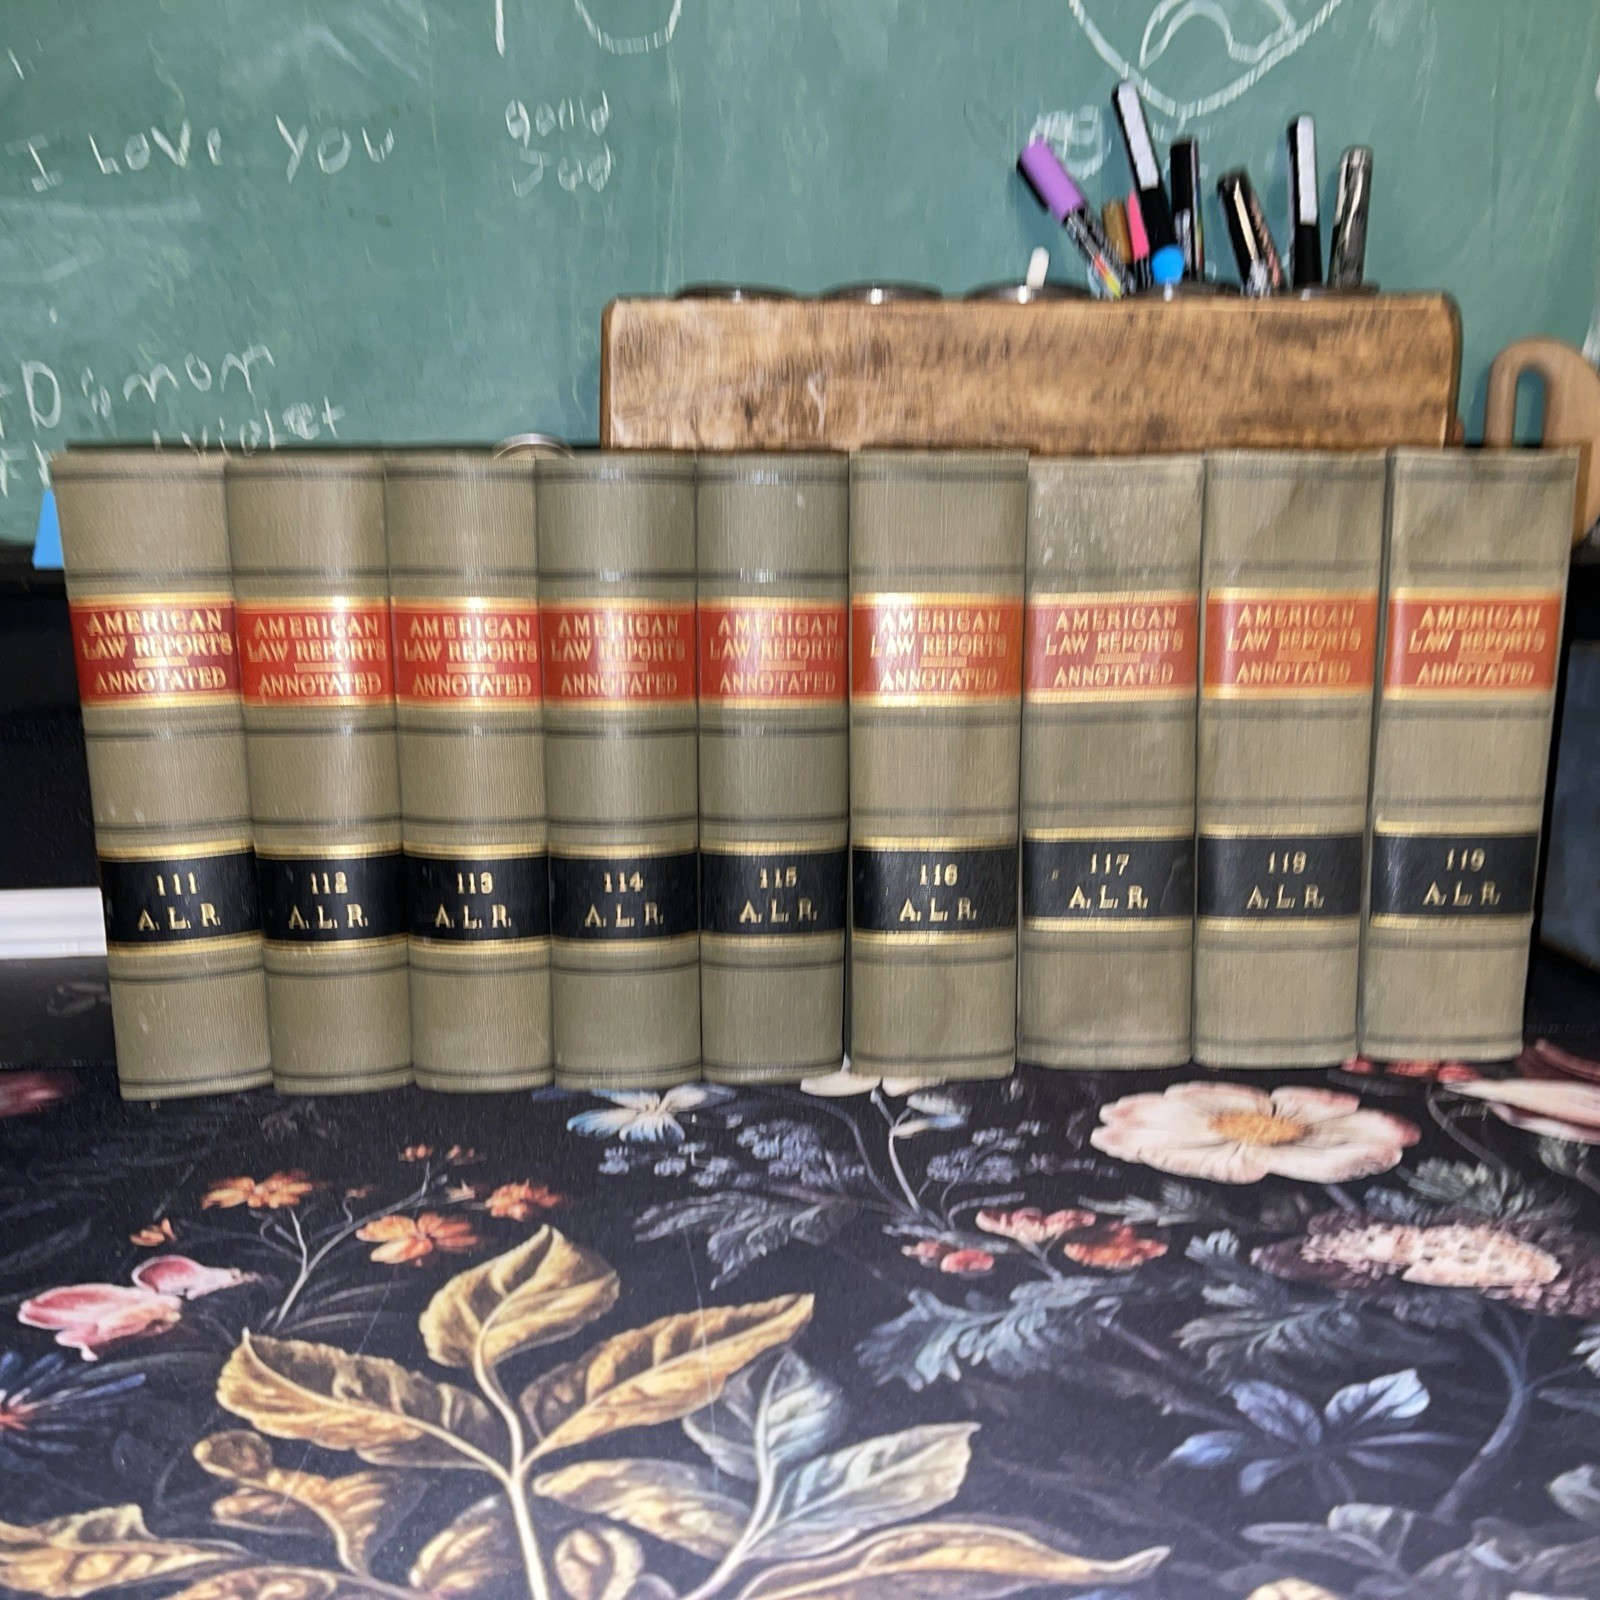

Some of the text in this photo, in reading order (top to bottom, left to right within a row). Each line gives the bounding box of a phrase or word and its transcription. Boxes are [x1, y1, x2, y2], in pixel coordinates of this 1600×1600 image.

[86, 608, 222, 637] AMERICAN
[254, 615, 378, 639] AMERICAN
[410, 616, 530, 639] AMERICAN
[558, 615, 679, 638] AMERICAN
[718, 614, 838, 637] AMERICAN
[879, 610, 1000, 633] AMERICAN
[1055, 606, 1178, 632] AMERICAN
[1237, 604, 1355, 629] AMERICAN
[1419, 606, 1541, 630] AMERICAN
[82, 631, 233, 660] LAW REPORTS
[247, 639, 386, 662] LAW REPORTS
[403, 639, 537, 663] LAW REPORTS
[551, 639, 685, 662] LAW REPORTS
[710, 636, 844, 660] LAW REPORTS
[870, 634, 1007, 658] LAW REPORTS
[1045, 630, 1184, 656] LAW REPORTS
[1227, 628, 1361, 652] LAW REPORTS
[1408, 629, 1546, 653] LAW REPORTS
[95, 665, 227, 694] ANNOTATED
[260, 672, 382, 696] ANNOTATED
[413, 673, 531, 696] ANNOTATED
[561, 673, 677, 696] ANNOTATED
[720, 671, 836, 693] ANNOTATED
[879, 668, 997, 691] ANNOTATED
[1054, 663, 1174, 688] ANNOTATED
[1236, 661, 1350, 684] ANNOTATED
[1416, 662, 1535, 686] ANNOTATED
[1090, 853, 1129, 876] 117
[156, 871, 197, 896] 111
[604, 871, 643, 893] 114
[760, 866, 797, 888] 115
